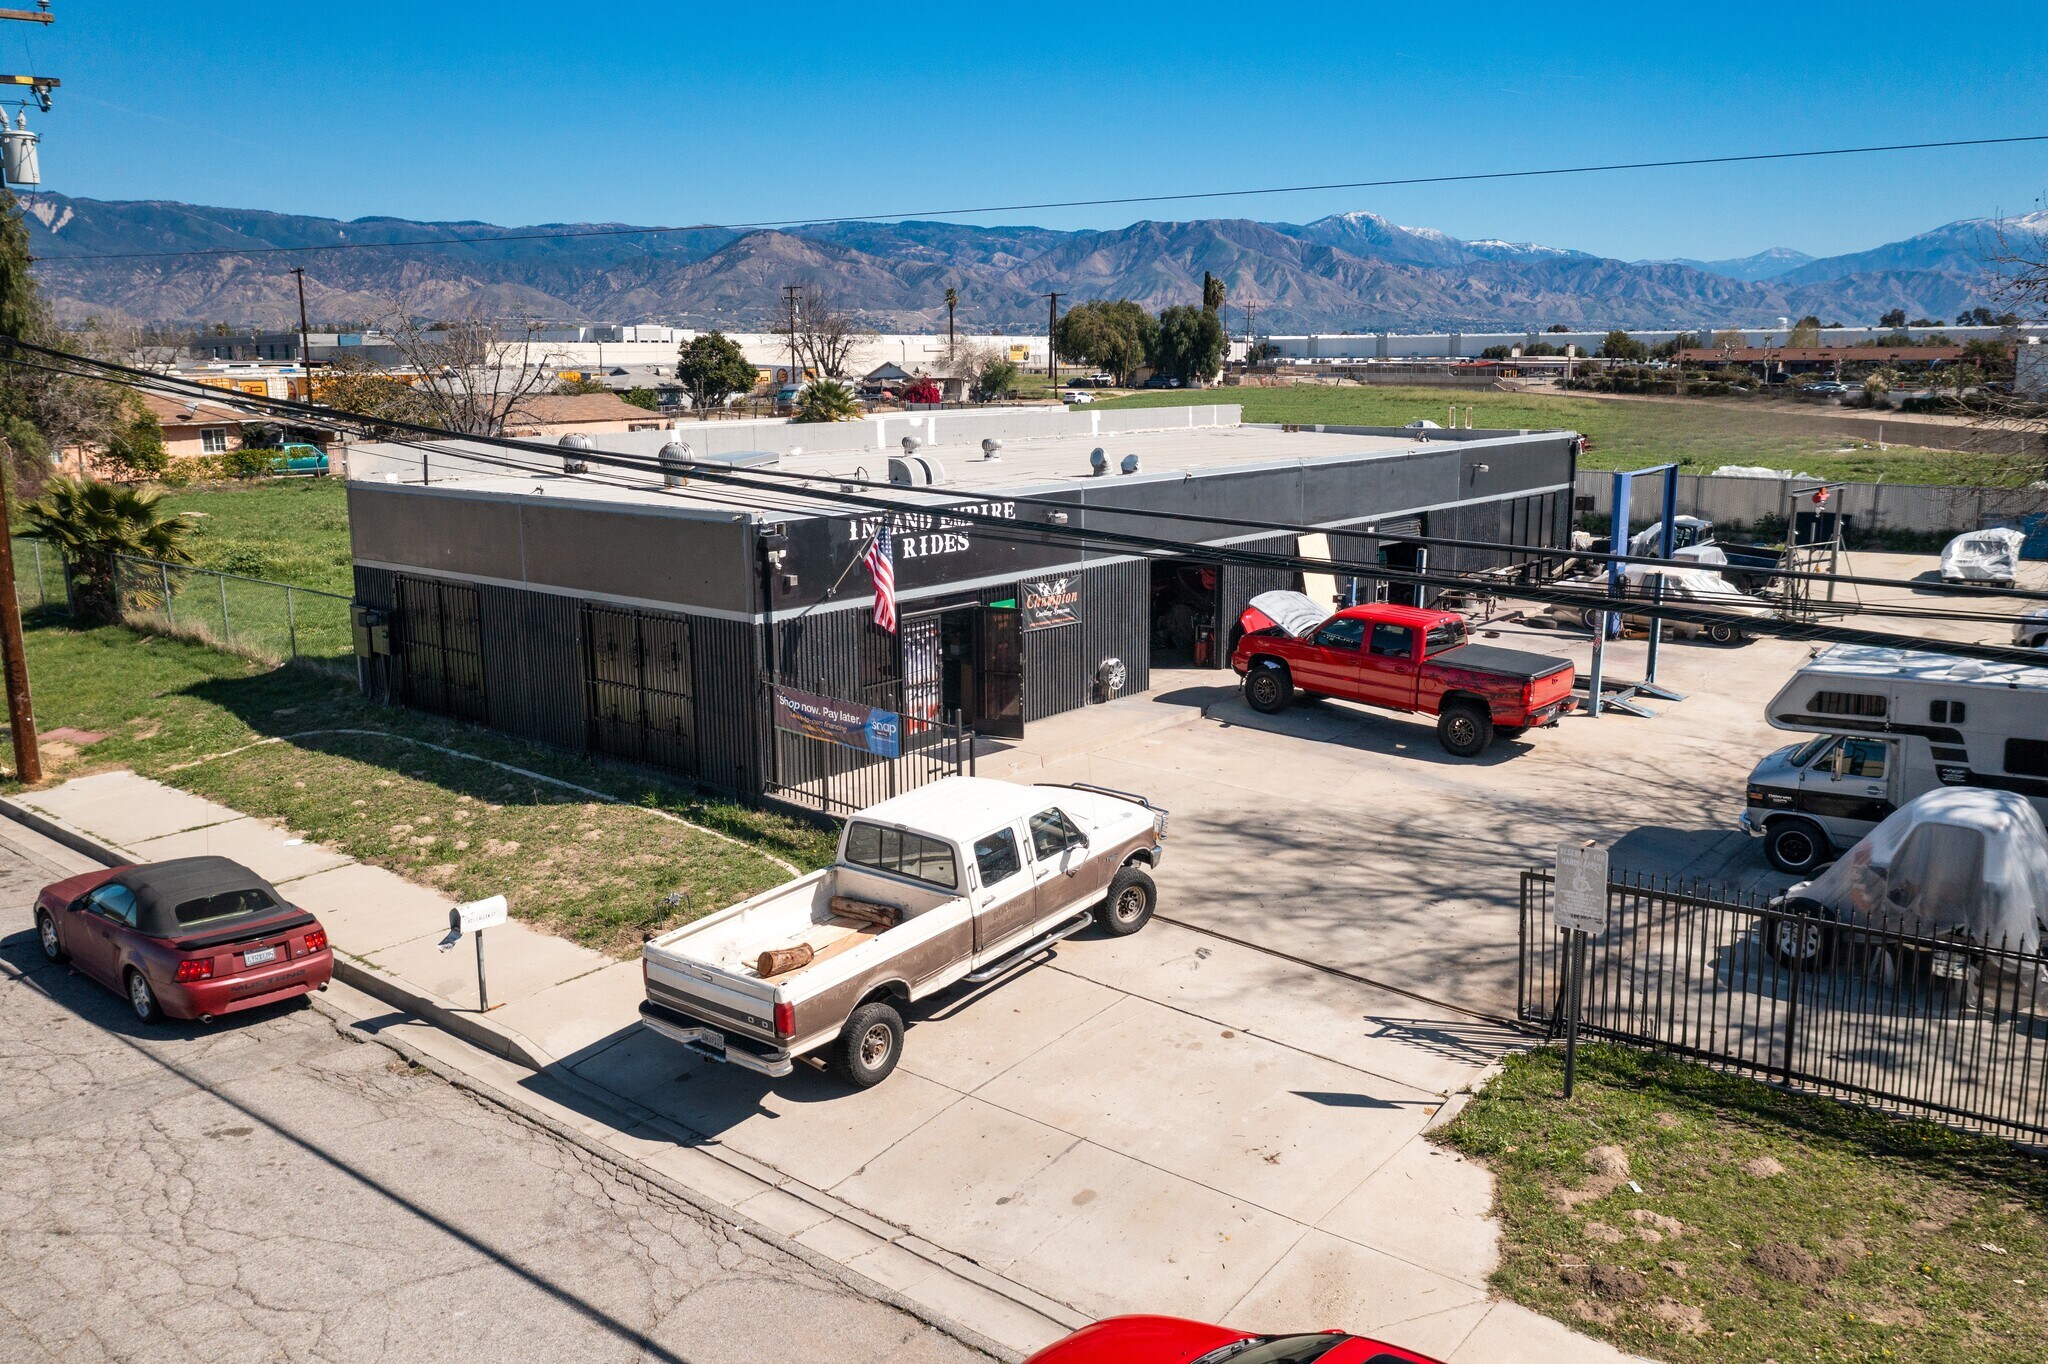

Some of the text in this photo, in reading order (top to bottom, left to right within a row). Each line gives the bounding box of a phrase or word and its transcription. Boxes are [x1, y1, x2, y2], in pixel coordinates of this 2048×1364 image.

[849, 513, 932, 541] INAND
[903, 531, 970, 559] RIDES
[1026, 590, 1077, 609] Champion
[779, 695, 861, 725] Shop now. Pay later.
[824, 720, 847, 734] financing
[871, 721, 896, 736] snap
[1560, 848, 1590, 860] RESERED
[231, 969, 306, 992] MUSTANG
